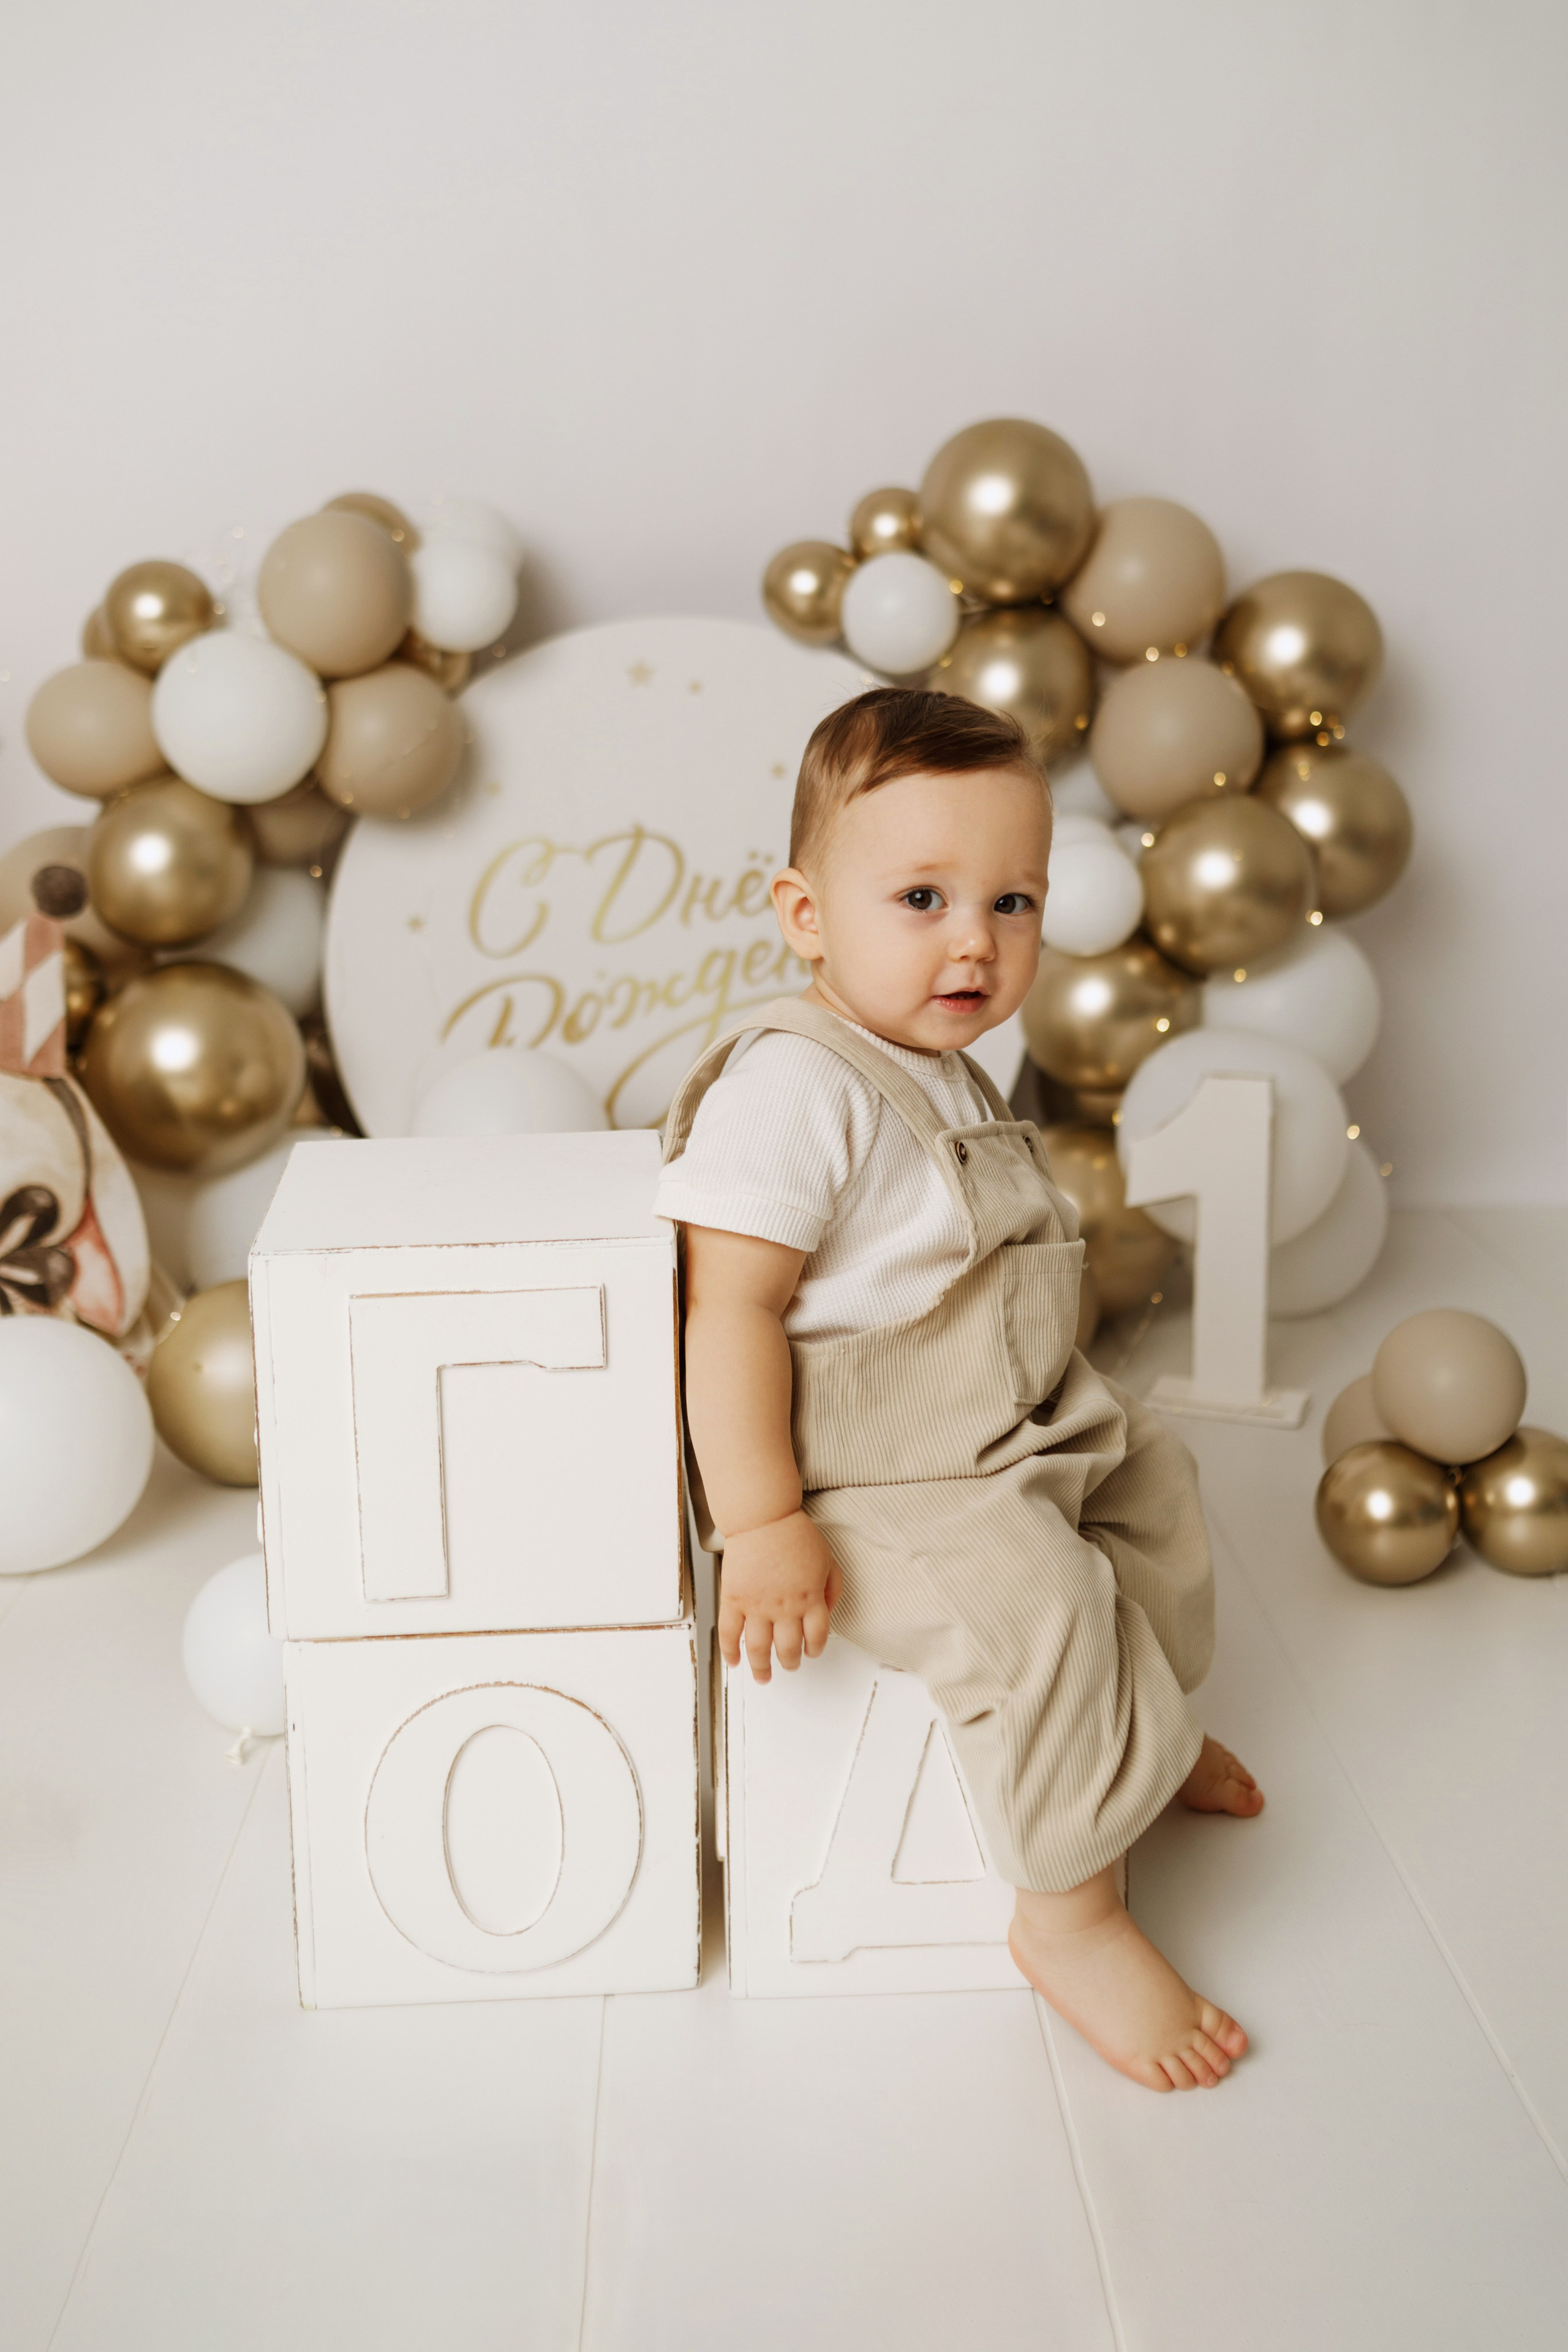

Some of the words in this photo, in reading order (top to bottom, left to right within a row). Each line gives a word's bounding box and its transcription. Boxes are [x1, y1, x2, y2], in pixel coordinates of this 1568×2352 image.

[469, 835, 553, 959] С
[585, 823, 775, 945] Днё
[1125, 1069, 1310, 1428] 1
[349, 1283, 607, 1602] Г
[365, 1681, 645, 1975] О
